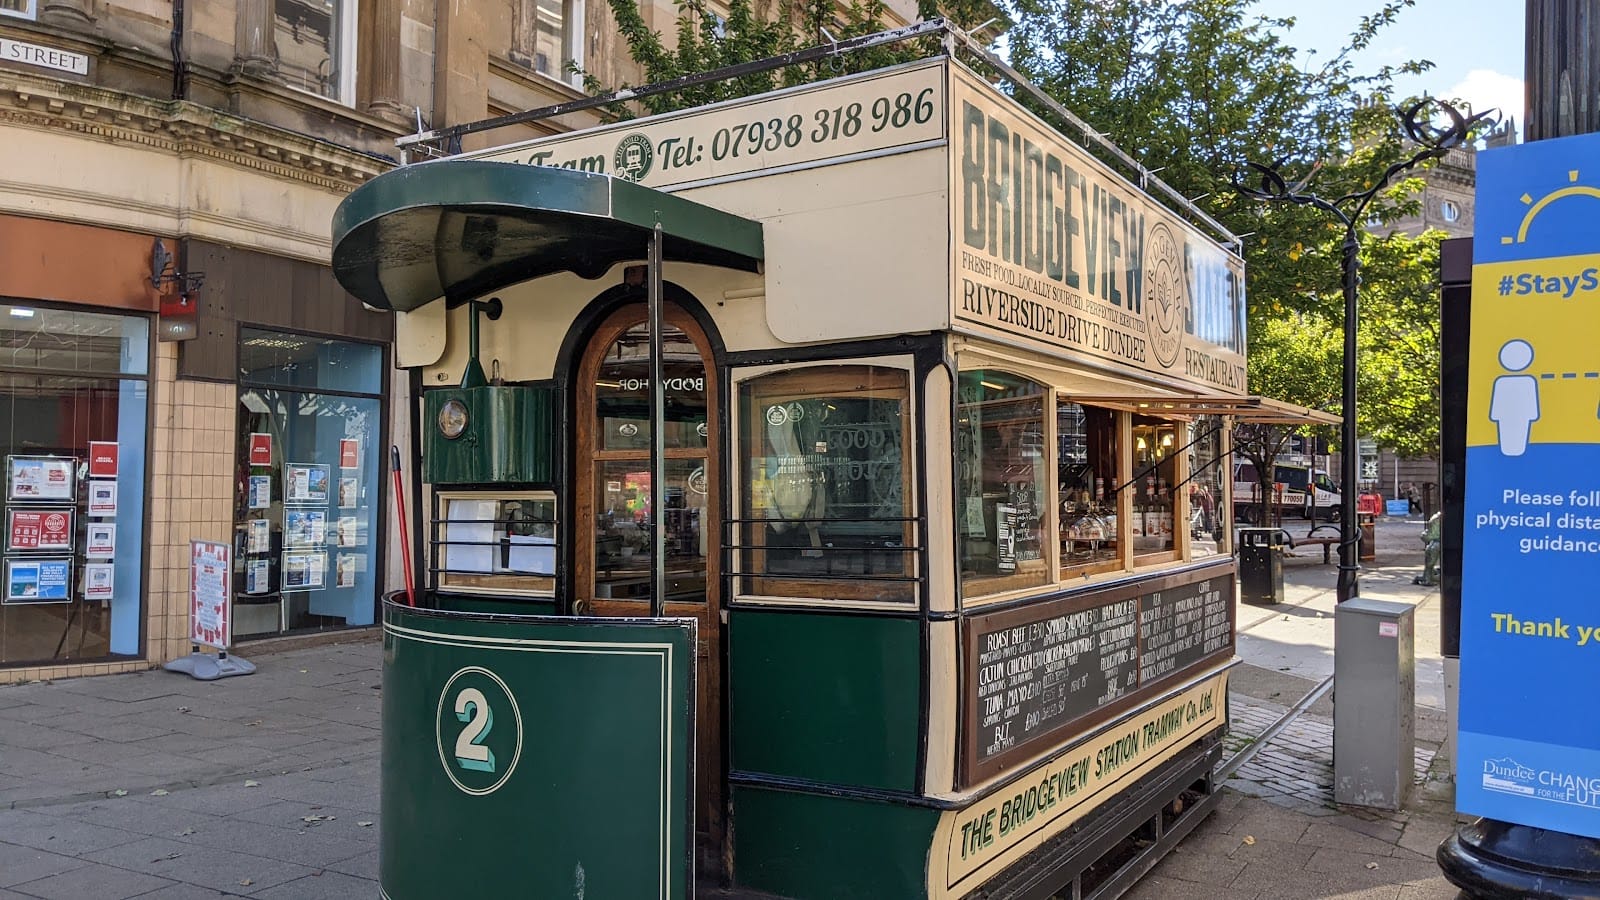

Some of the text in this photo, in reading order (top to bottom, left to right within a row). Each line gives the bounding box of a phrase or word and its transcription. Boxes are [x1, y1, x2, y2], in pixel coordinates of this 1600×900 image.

[11, 44, 80, 69] STREET
[657, 87, 934, 171] Tel: 07938 318 986
[962, 100, 1145, 315] BRIDGEVIEW
[962, 251, 992, 278] FRESH
[1119, 312, 1146, 334] EXECUTED
[1498, 268, 1598, 299] #StayS
[962, 278, 1146, 363] RIVERSIDE DRIVE DUNDEE
[1184, 347, 1245, 392] RESTAURANT
[1503, 489, 1563, 506] Please
[1476, 510, 1550, 530] physical
[1519, 535, 1600, 553] guidanc
[987, 629, 1011, 651] ROAST
[1012, 626, 1027, 645] BEEF
[1491, 613, 1570, 639] Thank
[980, 662, 1004, 685] CAJUN
[1006, 653, 1033, 676] CHICKEN
[984, 693, 1004, 716] TUNA
[1007, 685, 1027, 708] MAYO
[455, 687, 495, 773] 2
[994, 720, 1013, 744] BLT
[961, 806, 998, 861] THE
[998, 756, 1092, 838] BRIDGEVIEW
[1094, 726, 1141, 780] STATION
[1142, 703, 1185, 750] TRAMWAY
[1483, 760, 1536, 780] Dundee
